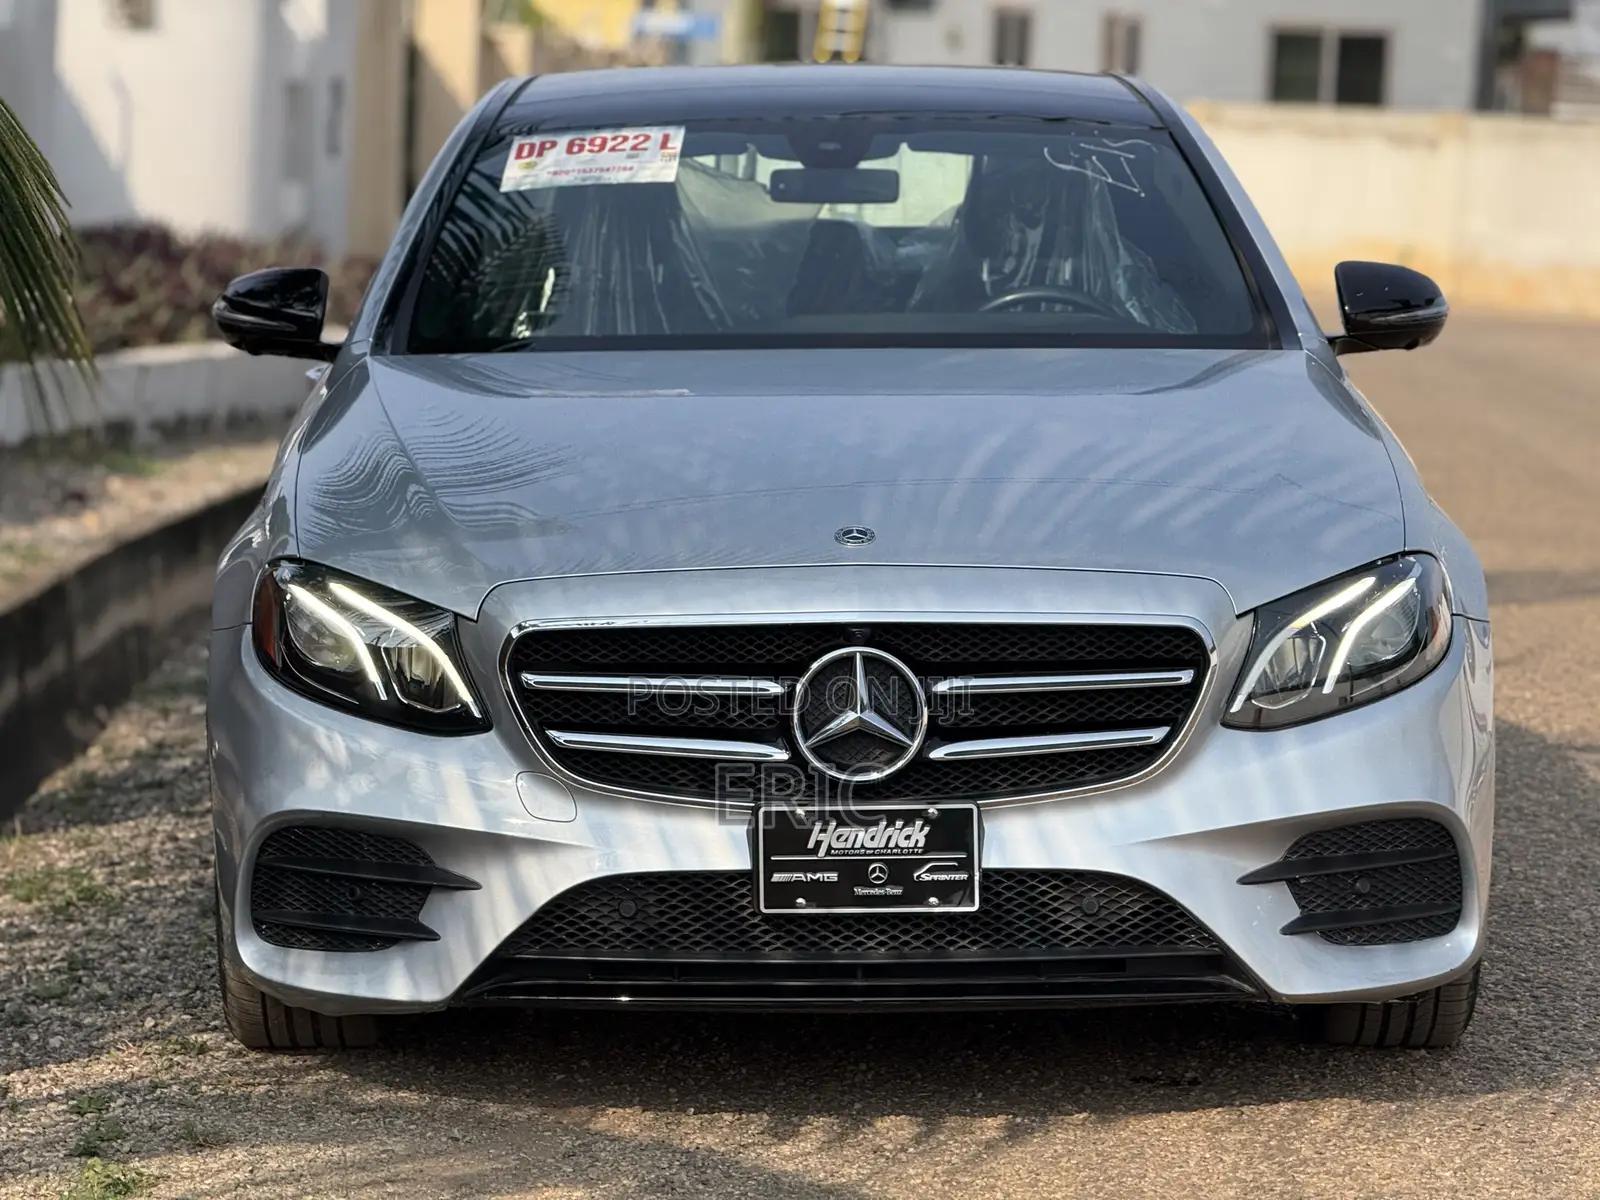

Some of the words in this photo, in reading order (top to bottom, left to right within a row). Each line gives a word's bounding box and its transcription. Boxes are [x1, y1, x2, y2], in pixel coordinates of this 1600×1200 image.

[514, 139, 558, 160] DP
[565, 133, 652, 155] 6922
[660, 133, 677, 150] L
[807, 820, 931, 857] Hendrick
[791, 873, 839, 882] AMG
[919, 873, 969, 881] SPRINTER
[853, 888, 903, 896] Mercedes-Benz
